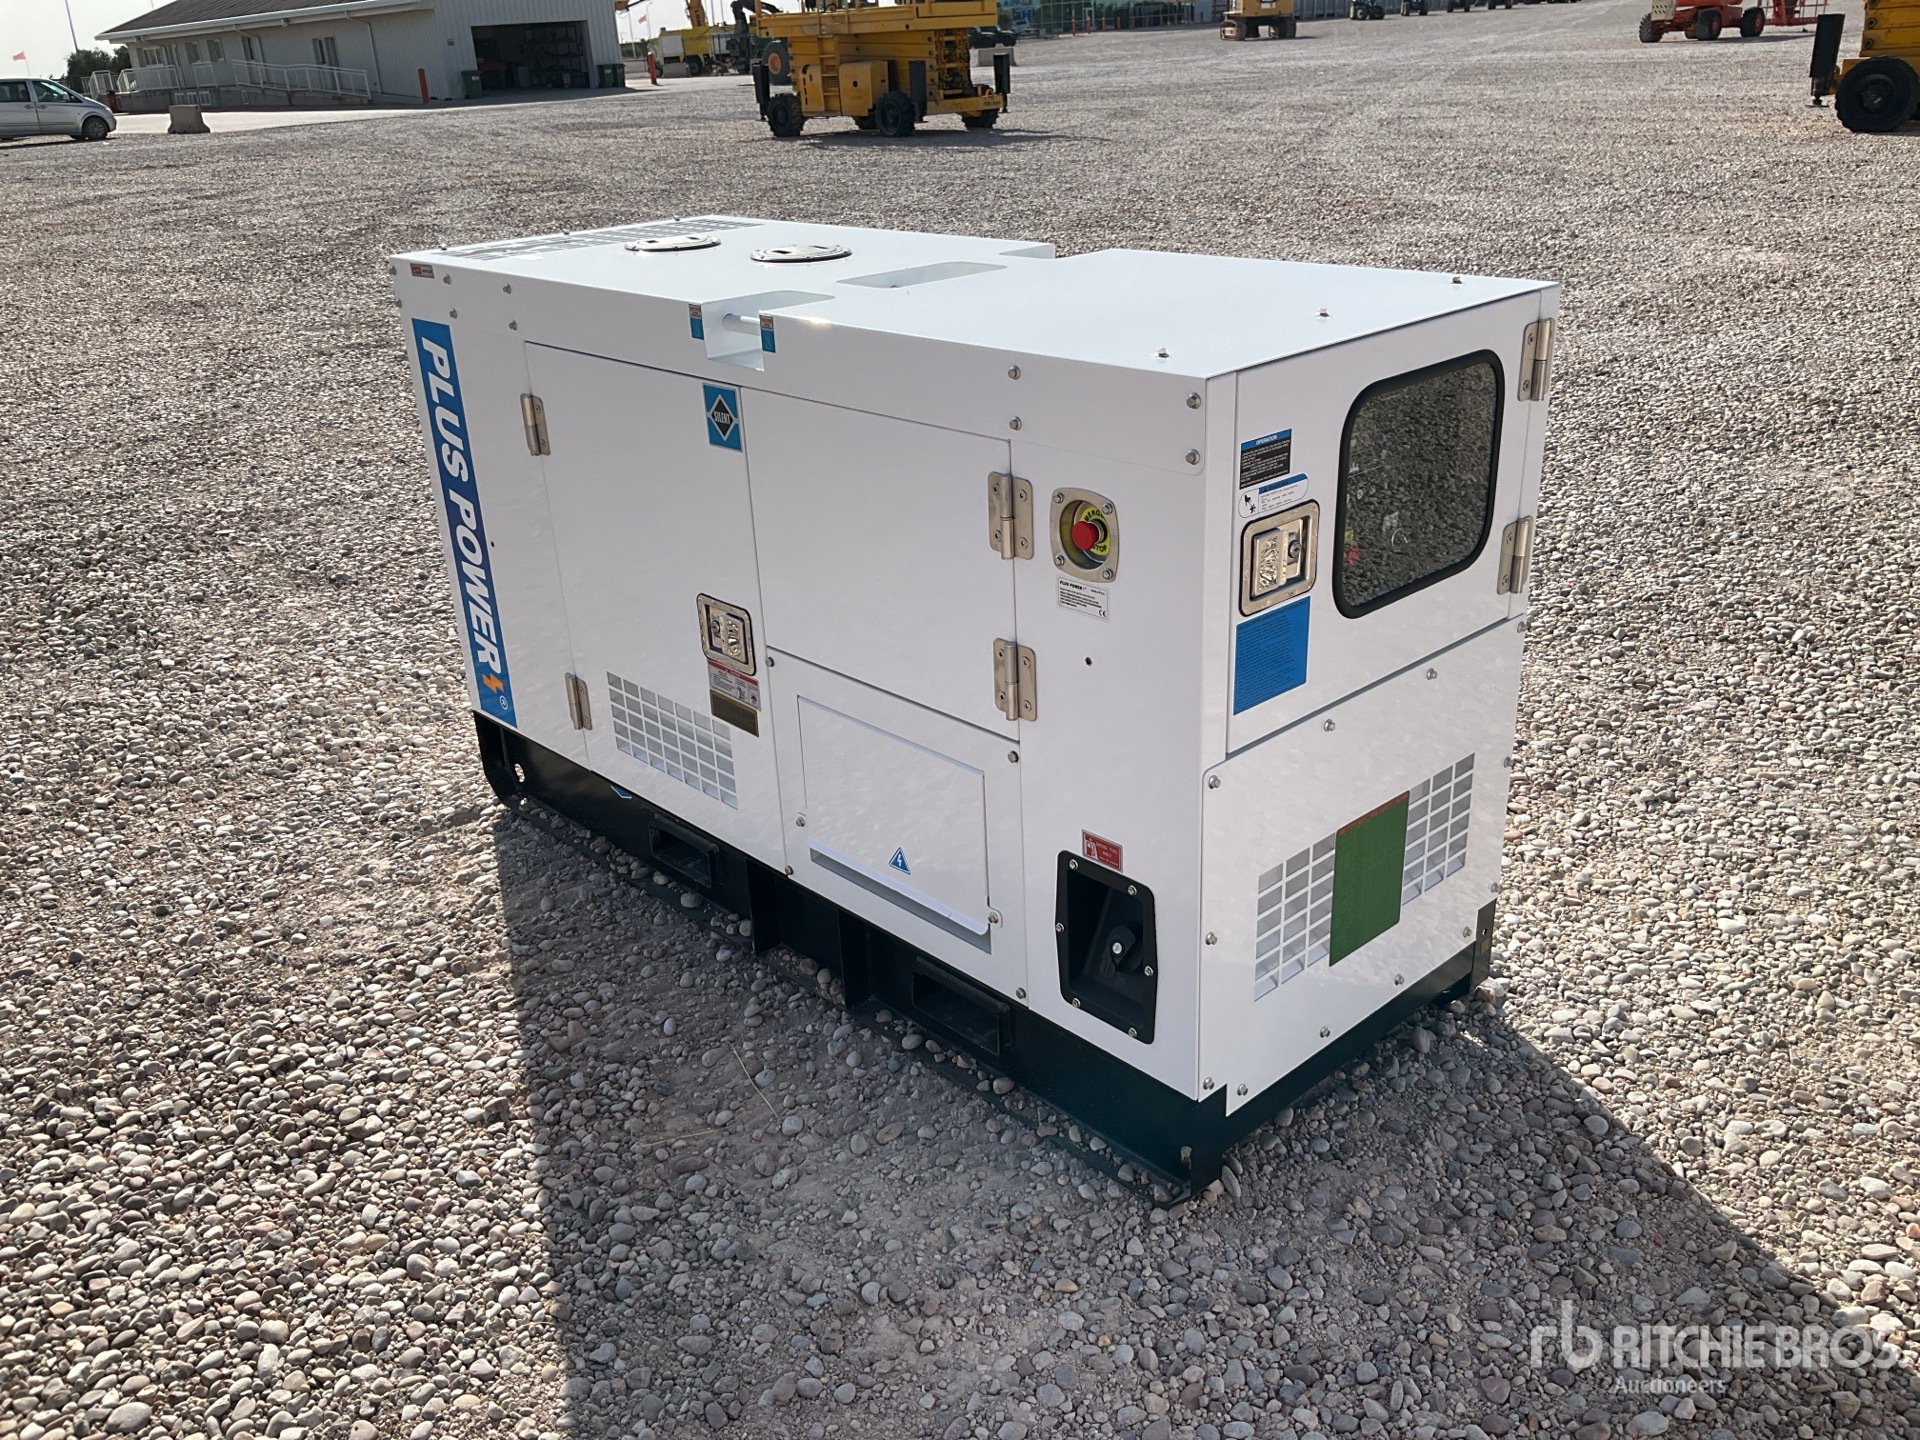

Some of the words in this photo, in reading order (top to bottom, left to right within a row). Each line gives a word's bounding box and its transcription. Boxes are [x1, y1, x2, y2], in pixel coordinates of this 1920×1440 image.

[713, 411, 730, 424] SILENT
[422, 337, 468, 482] PLUS
[449, 489, 501, 673] POWER
